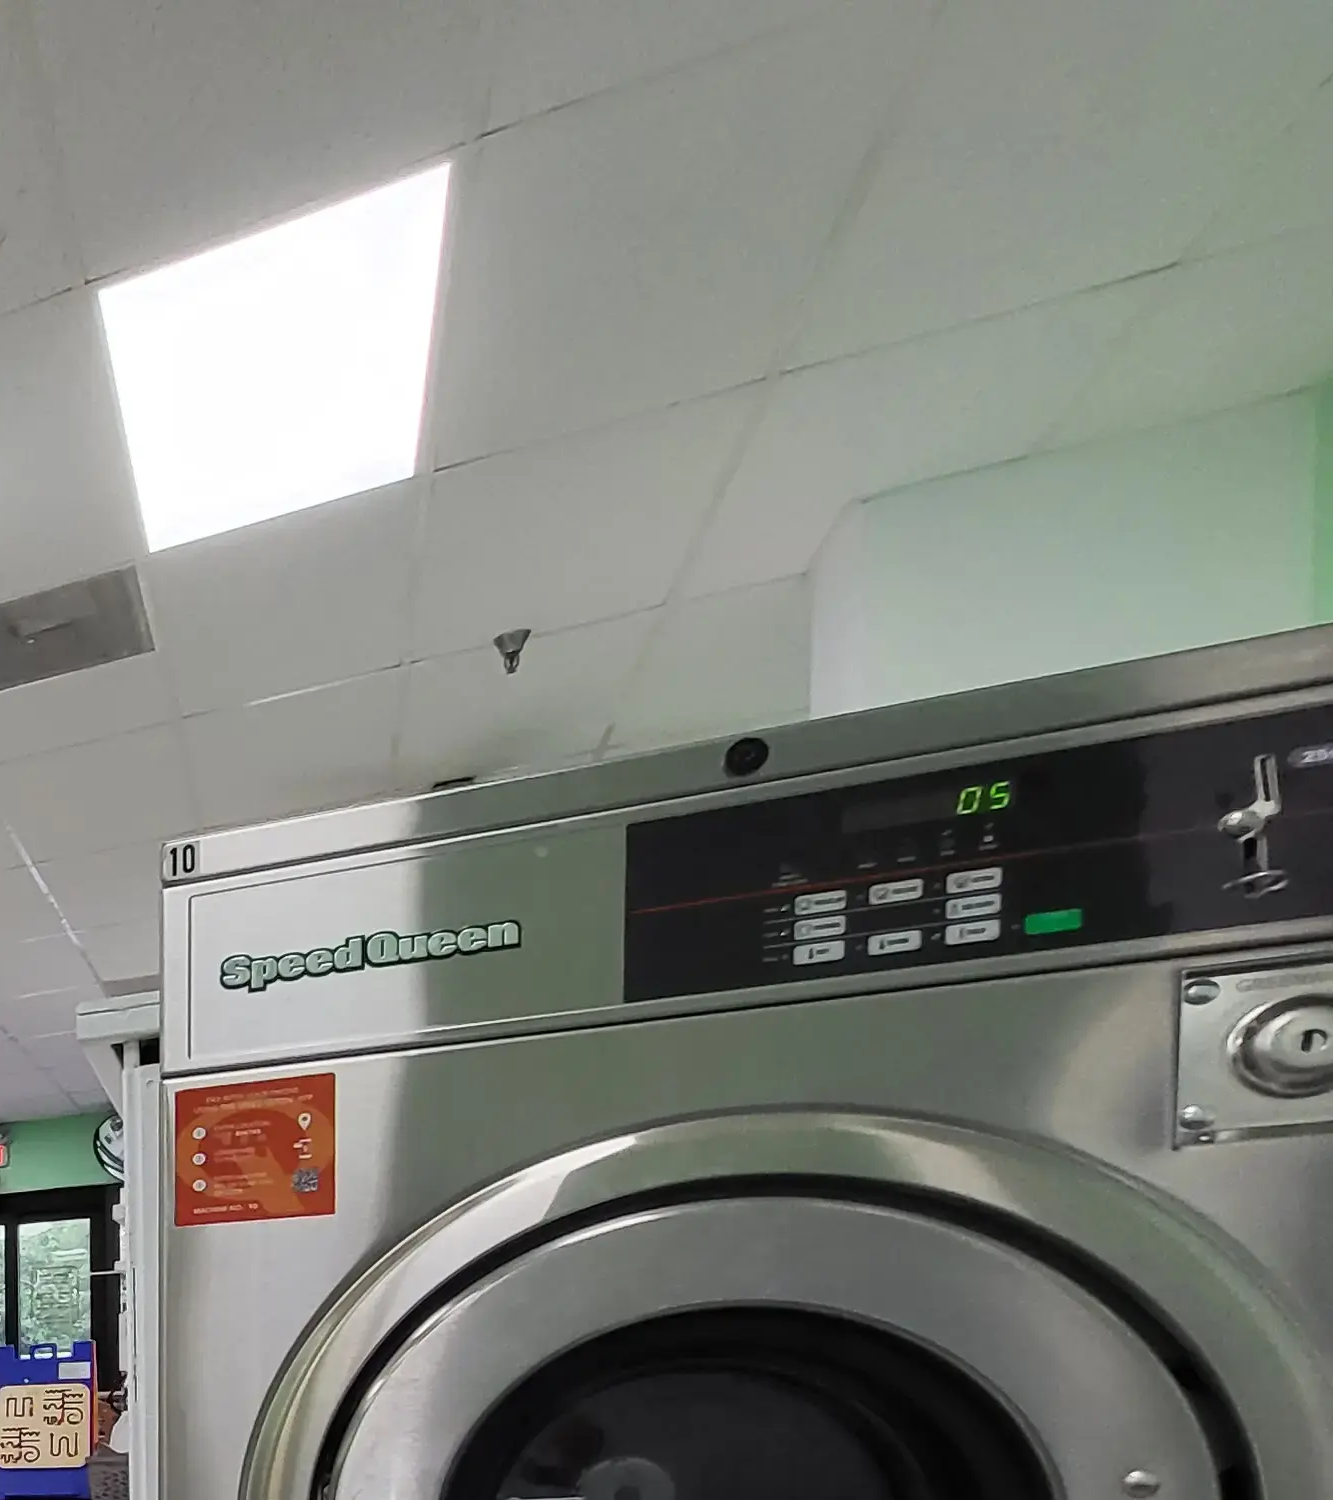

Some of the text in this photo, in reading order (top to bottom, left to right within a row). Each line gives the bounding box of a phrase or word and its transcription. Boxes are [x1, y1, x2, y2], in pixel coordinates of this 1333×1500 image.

[956, 780, 1011, 815] 05
[170, 844, 195, 877] 10
[220, 919, 522, 993] Speed Queen
